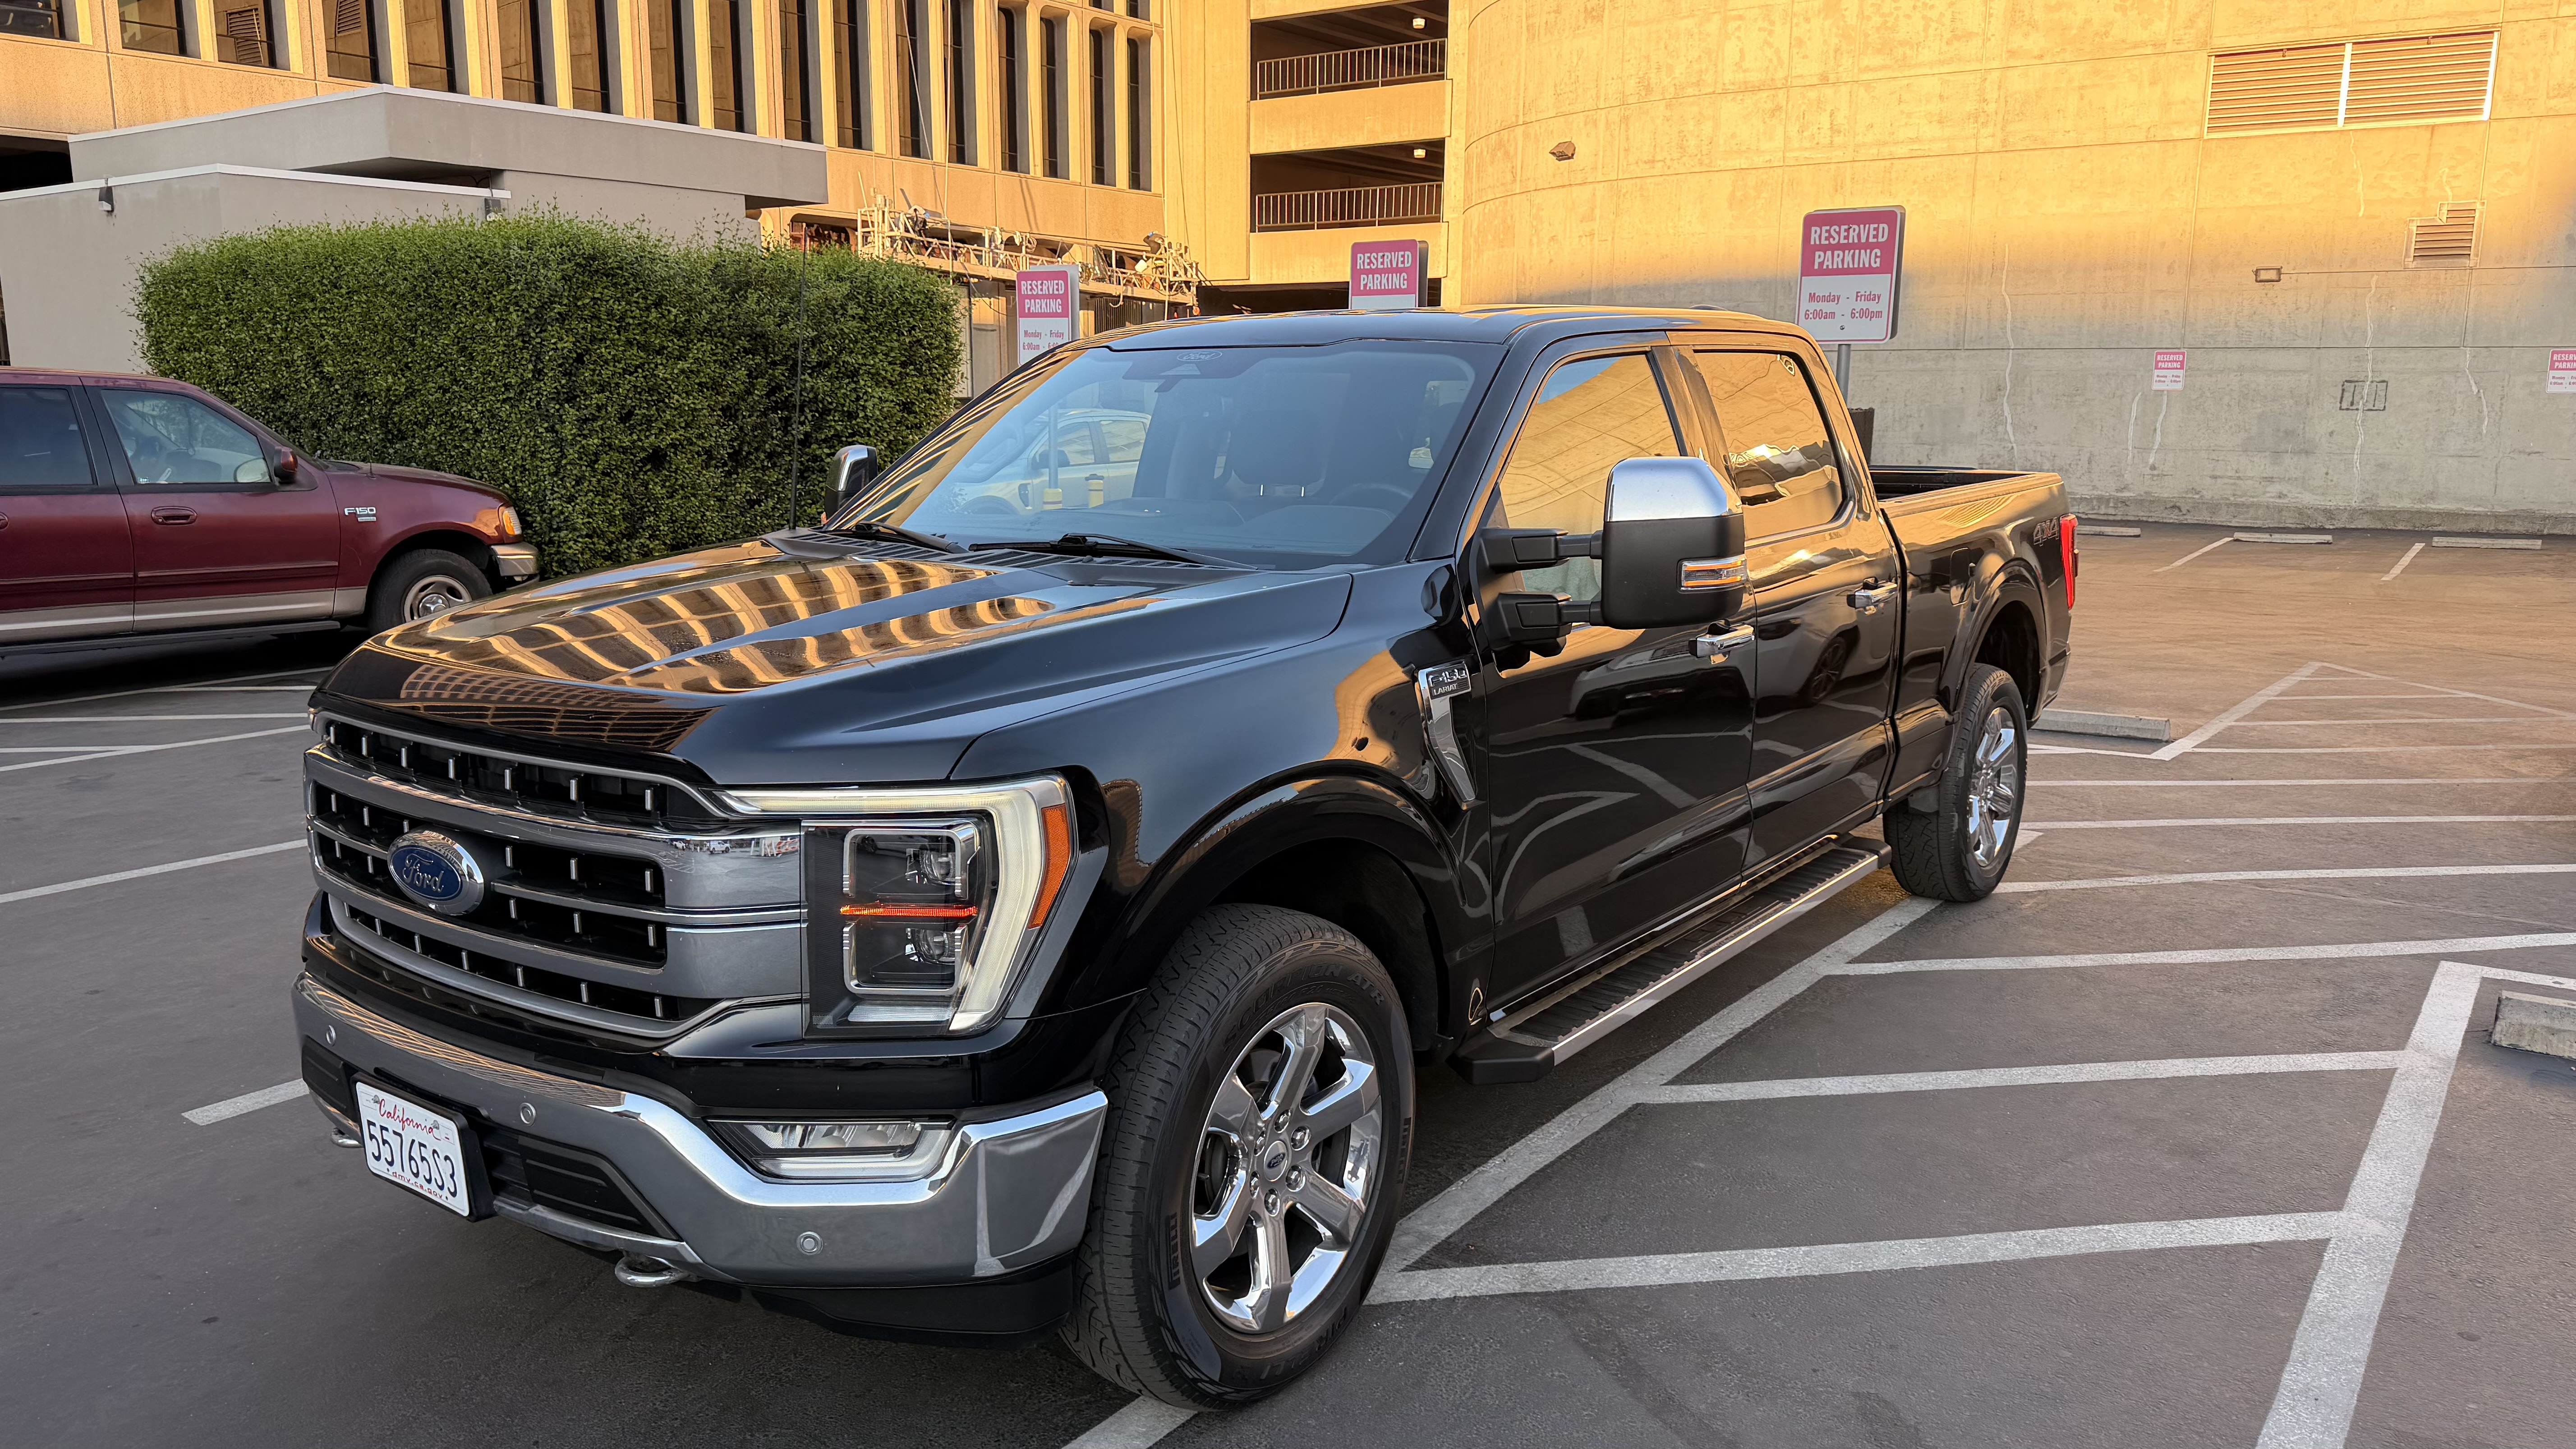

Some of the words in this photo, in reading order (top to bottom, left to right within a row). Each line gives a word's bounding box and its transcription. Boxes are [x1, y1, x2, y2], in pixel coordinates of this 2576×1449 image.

[1810, 223, 1889, 244] RESERVED
[1357, 251, 1412, 269] RESERVED
[1814, 248, 1881, 269] PARKING
[1021, 280, 1065, 294] RESERVED
[1360, 272, 1408, 290] PARKING
[1025, 299, 1062, 313] PARKING
[1808, 292, 1841, 305] Monday
[1855, 291, 1881, 304] Friday
[1804, 309, 1835, 320] 6:00am
[1850, 308, 1883, 321] 6:00pm
[1024, 330, 1042, 340] Monday
[1049, 330, 1064, 339] Friday
[1022, 342, 1040, 350] 6:00am
[1434, 683, 1458, 695] LARIAT
[402, 853, 444, 892] Ford
[1222, 962, 1344, 1052] SCORPION
[1347, 971, 1386, 1006] ATR
[379, 1099, 442, 1141] California
[367, 1119, 458, 1198] 55765S3
[392, 1171, 442, 1199] dmv.ca.gov
